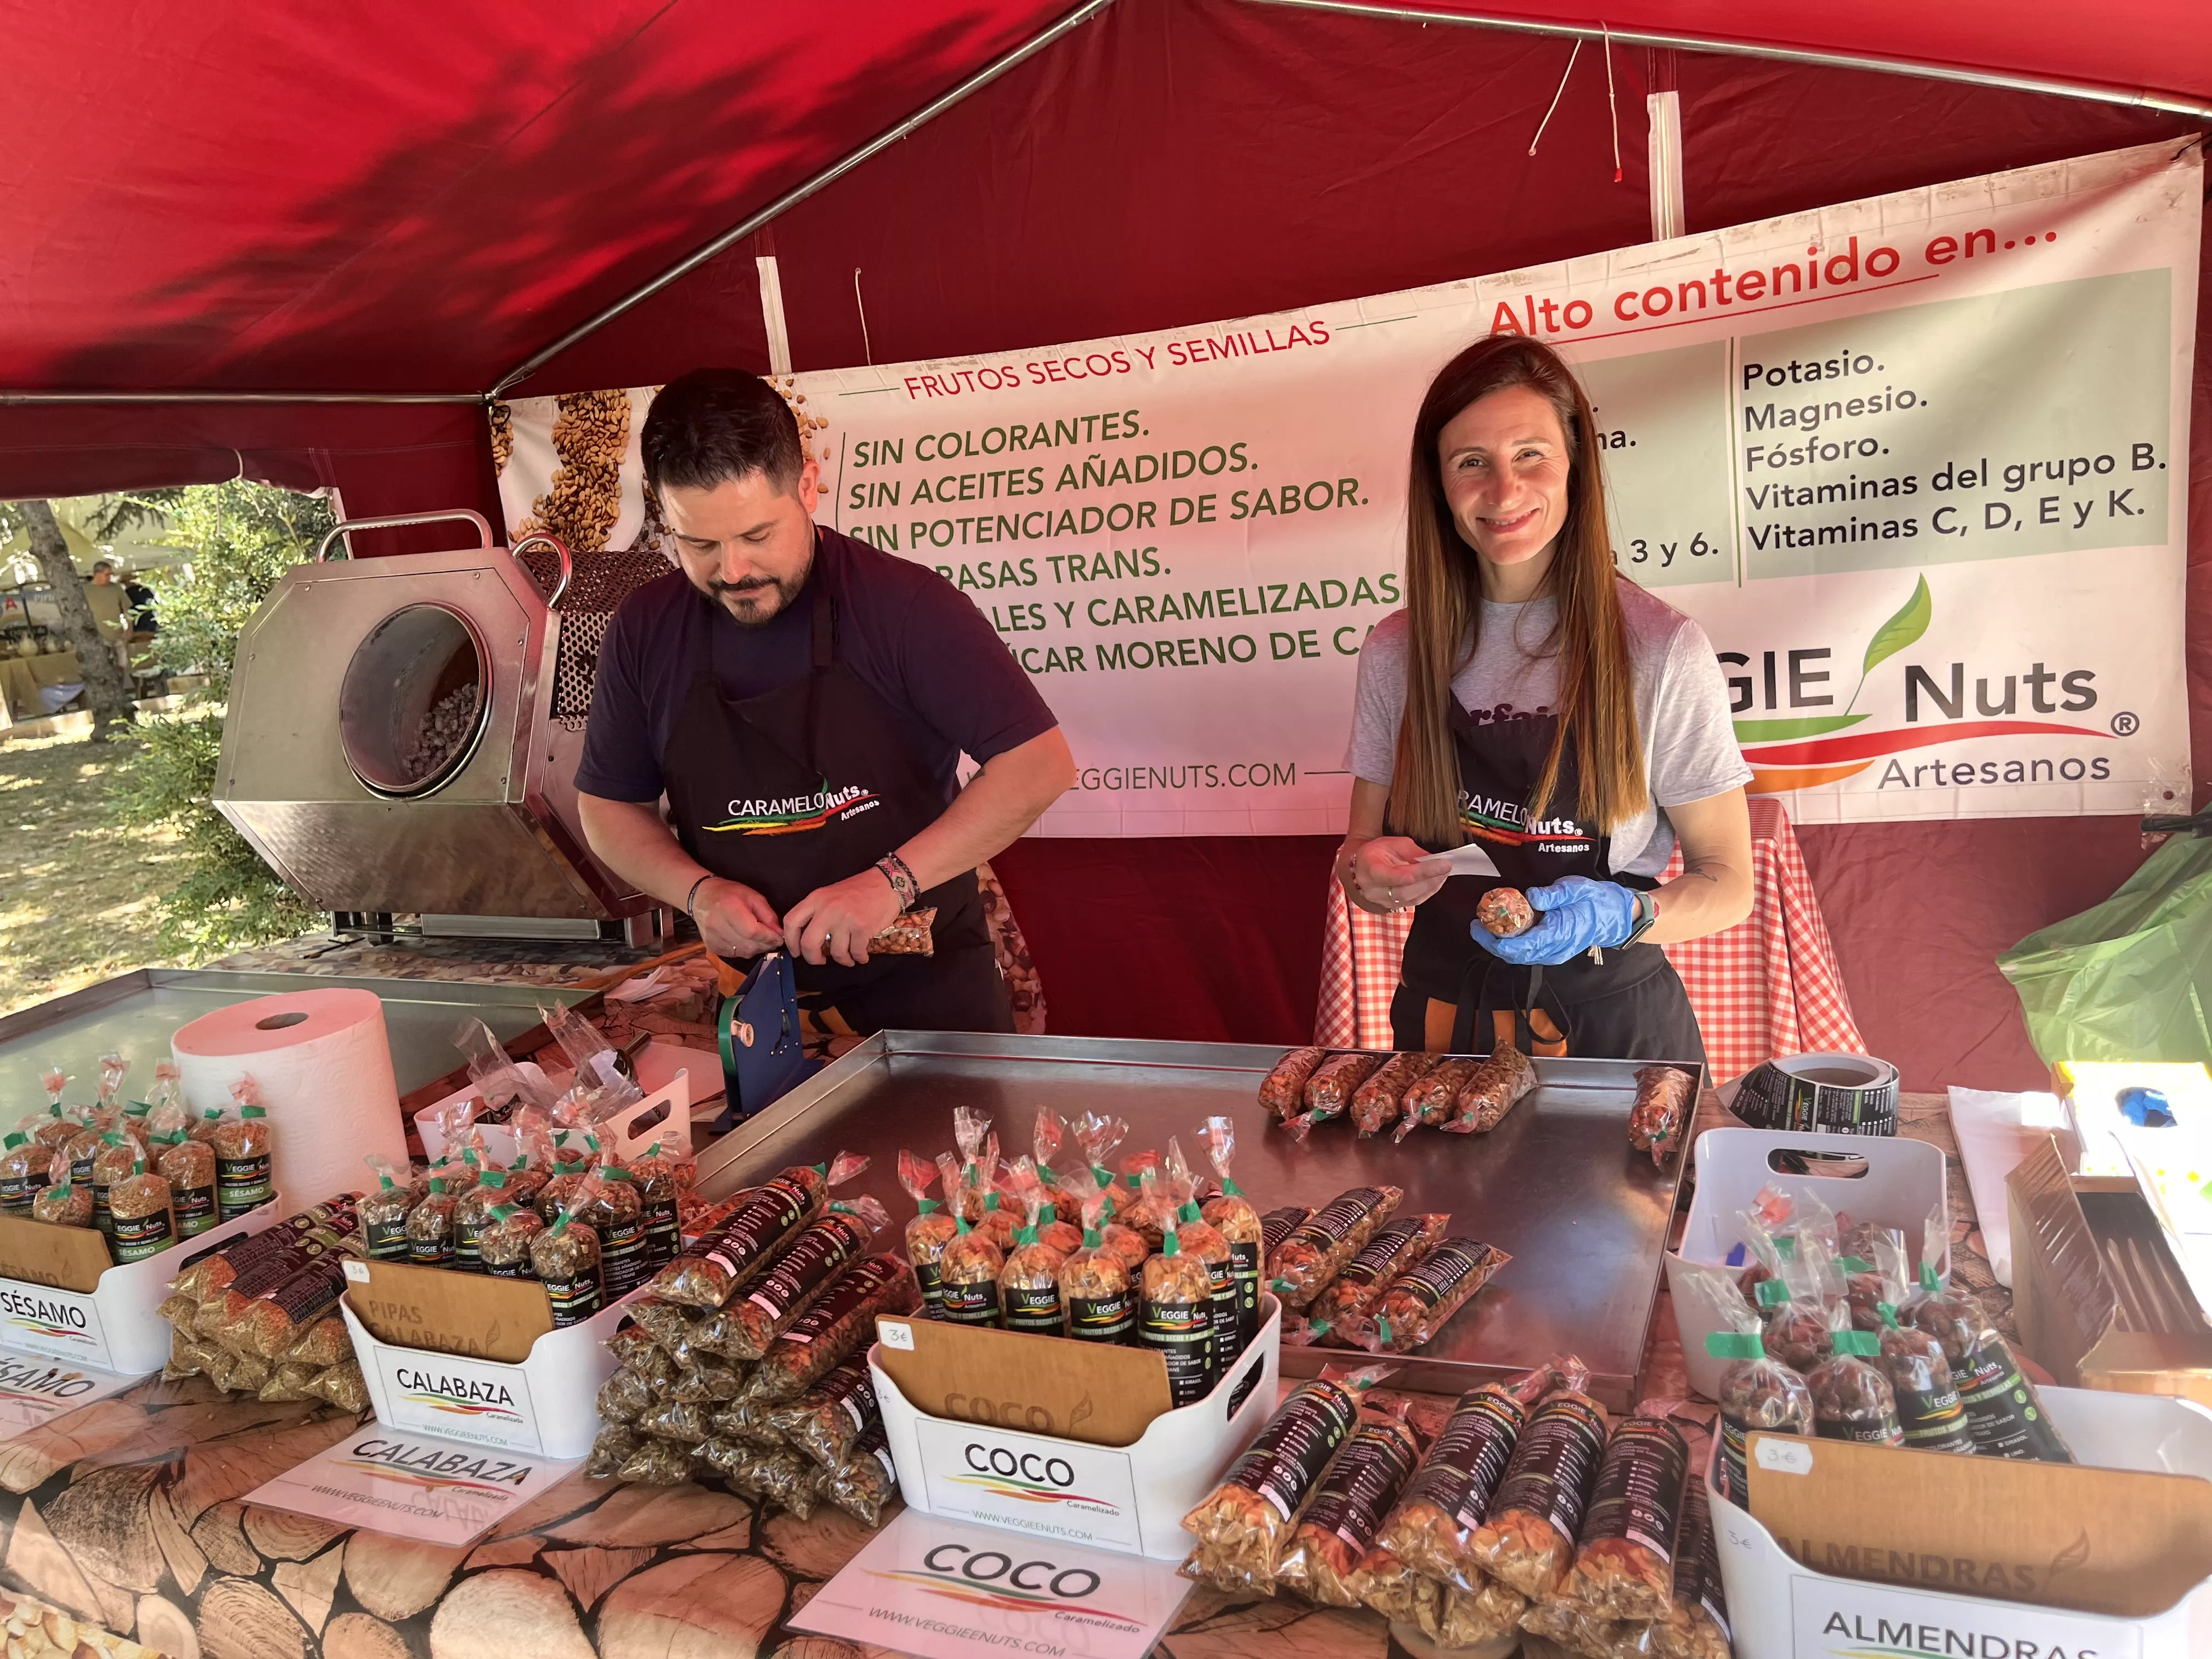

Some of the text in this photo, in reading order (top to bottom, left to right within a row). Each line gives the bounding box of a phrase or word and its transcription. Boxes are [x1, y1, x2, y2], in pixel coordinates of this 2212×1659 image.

[1489, 227, 2058, 337] Alto contenido en...
[904, 320, 1330, 400] FRUTOS SECOS Y SEMILLAS
[1743, 349, 1885, 391] Potasio.
[1744, 387, 1929, 434] Magnesio.
[853, 410, 1149, 467] SIN COLORANTES.
[1746, 432, 1889, 472] Fósforo.
[849, 442, 1257, 509] SIN ACEITES AÑADIDOS.
[1746, 442, 2166, 511] Vitaminas del grupo B.
[912, 500, 1155, 548] POTENCIADOR
[1169, 495, 1216, 526] DE
[1229, 477, 1368, 520] SABOR.
[1747, 488, 2145, 551] Vitaminas C, D, E y K.
[1046, 548, 1170, 583] TRANS.
[1630, 539, 1647, 563] 3
[1660, 542, 1678, 567] y
[1690, 532, 1718, 556] 6.
[978, 573, 1400, 631] LES Y CARAMELIZADAS
[1096, 631, 1256, 671] MORENO
[1269, 630, 1321, 659] DE
[1906, 662, 2098, 722] Nuts
[1877, 757, 2110, 789] Artesanos
[841, 799, 879, 821] Artesanos
[1538, 842, 1589, 853] Artesanos
[74, 1165, 91, 1173] EGGIE
[225, 1163, 255, 1172] VEGGIE
[229, 1186, 264, 1198] SÉSAMO
[411, 1242, 437, 1252] VEGGIE
[605, 1226, 636, 1239] VEGGIE
[488, 1265, 516, 1277] VEGGIE
[574, 1279, 591, 1289] Nuts
[1, 1290, 87, 1329] SÉSAMO
[369, 1300, 423, 1324] PIPAS
[964, 1293, 983, 1301] Nuts
[1021, 1293, 1055, 1305] VEGGIE
[1087, 1301, 1121, 1314] VEGGIE
[1081, 1324, 1120, 1335] FRUTOS SECOS
[1153, 1306, 1206, 1321] VEGGIE Nuts
[369, 1321, 482, 1355] CALABAZA
[889, 1329, 908, 1342] 3€
[1145, 1333, 1165, 1341] FRUTOS
[0, 1361, 95, 1397] SAMO
[1974, 1362, 1998, 1377] Nuts
[397, 1368, 515, 1407] CALABAZA
[1334, 1394, 1348, 1413] Nuts
[1984, 1380, 2013, 1399] SEMILLAS
[486, 1411, 524, 1425] Caramelizada
[944, 1392, 1054, 1432] COCO
[1550, 1402, 1587, 1415] VEGGIE
[1996, 1414, 2016, 1425] SABOR
[1842, 1427, 1888, 1441] VEGGIE
[353, 1440, 533, 1486] CALABAZA
[964, 1443, 1075, 1487] COCO
[311, 1483, 445, 1520] WWW.VEGGIEENUTS.COM
[452, 1486, 509, 1502] Caramelizada
[1066, 1500, 1120, 1517] Caramelizado
[973, 1509, 1093, 1541] WWW.VEGGIEENUTS.COM
[923, 1544, 1102, 1598] COCO
[1778, 1537, 2037, 1594] ALMENDRAS
[868, 1606, 1067, 1657] WWW.VEGGIEENUTS.COM
[1054, 1611, 1140, 1633] Caramelizado
